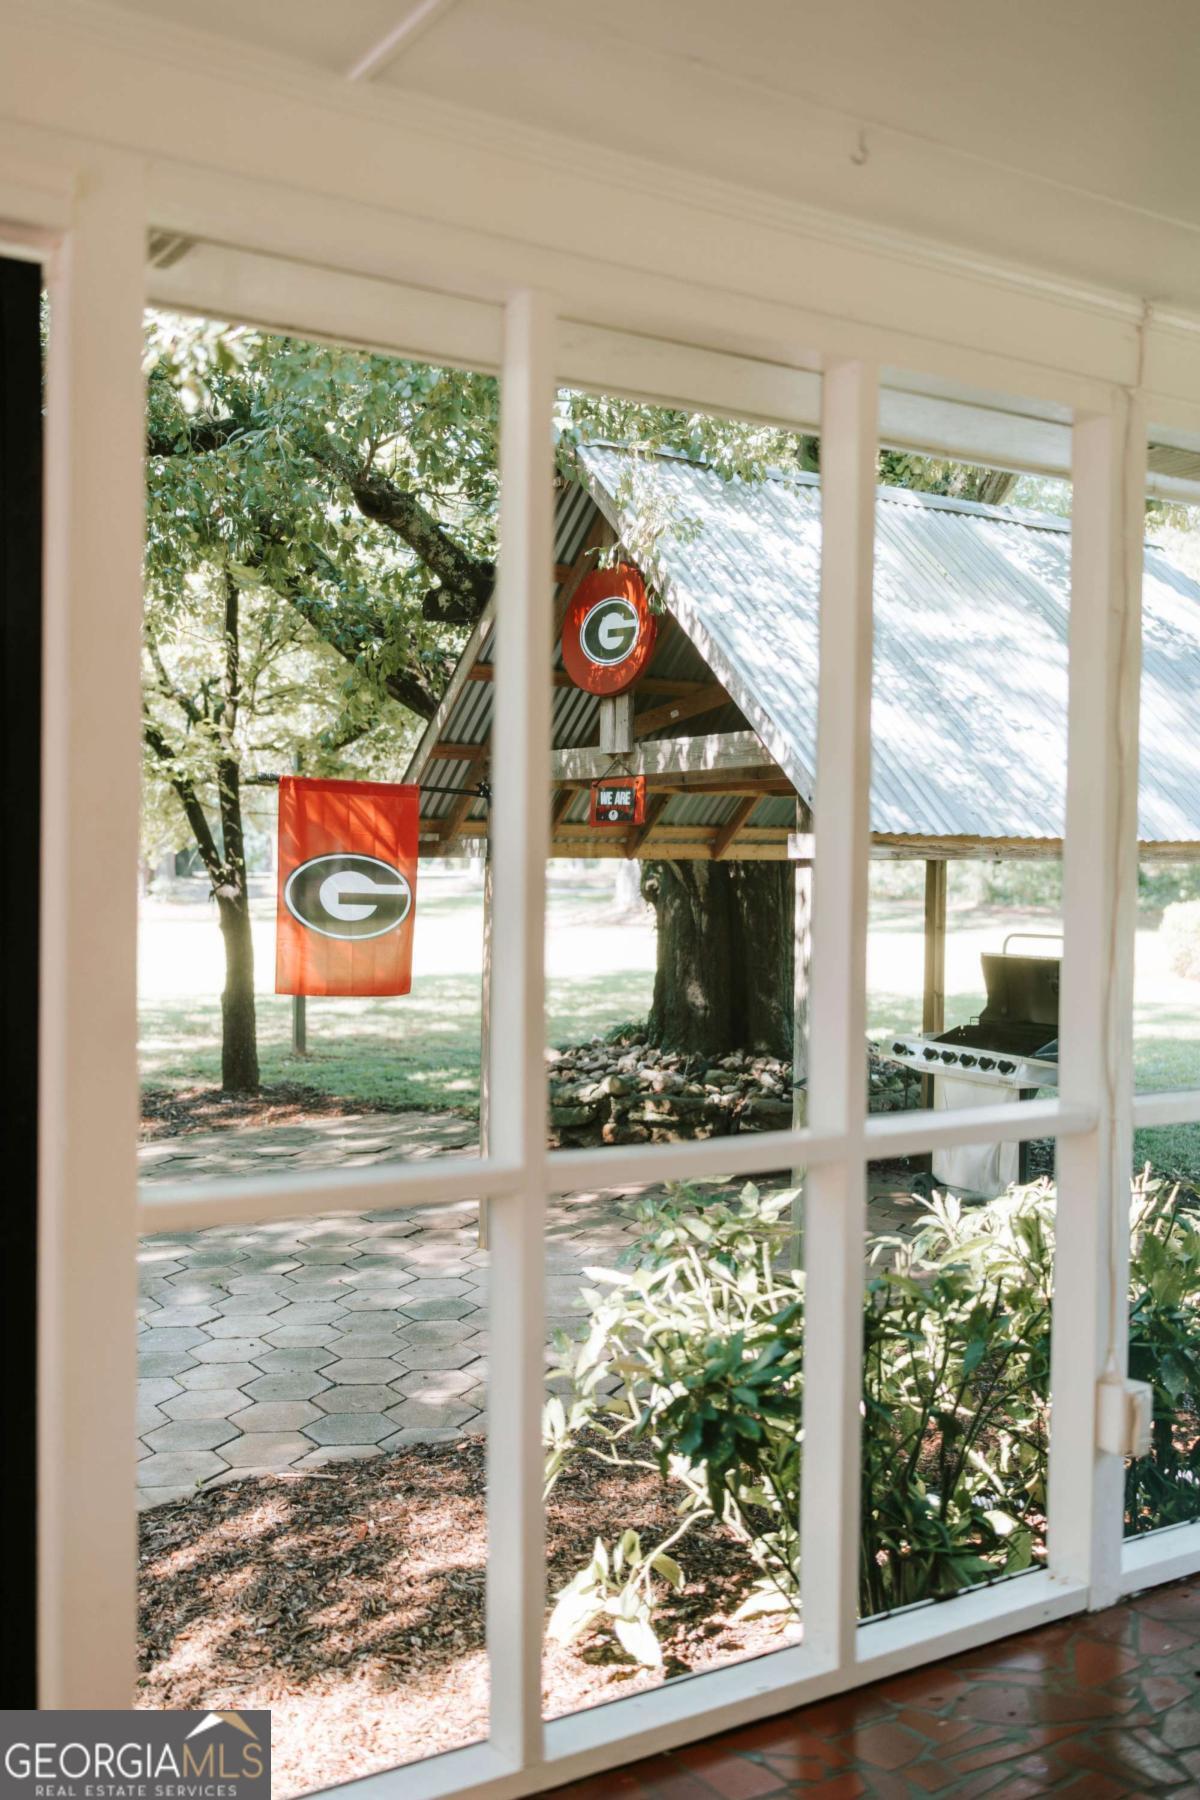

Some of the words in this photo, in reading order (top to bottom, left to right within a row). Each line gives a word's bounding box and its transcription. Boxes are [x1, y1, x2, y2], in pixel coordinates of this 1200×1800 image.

[598, 612, 637, 650] G
[600, 791, 613, 805] WE
[614, 791, 631, 805] ARE
[319, 870, 409, 921] G
